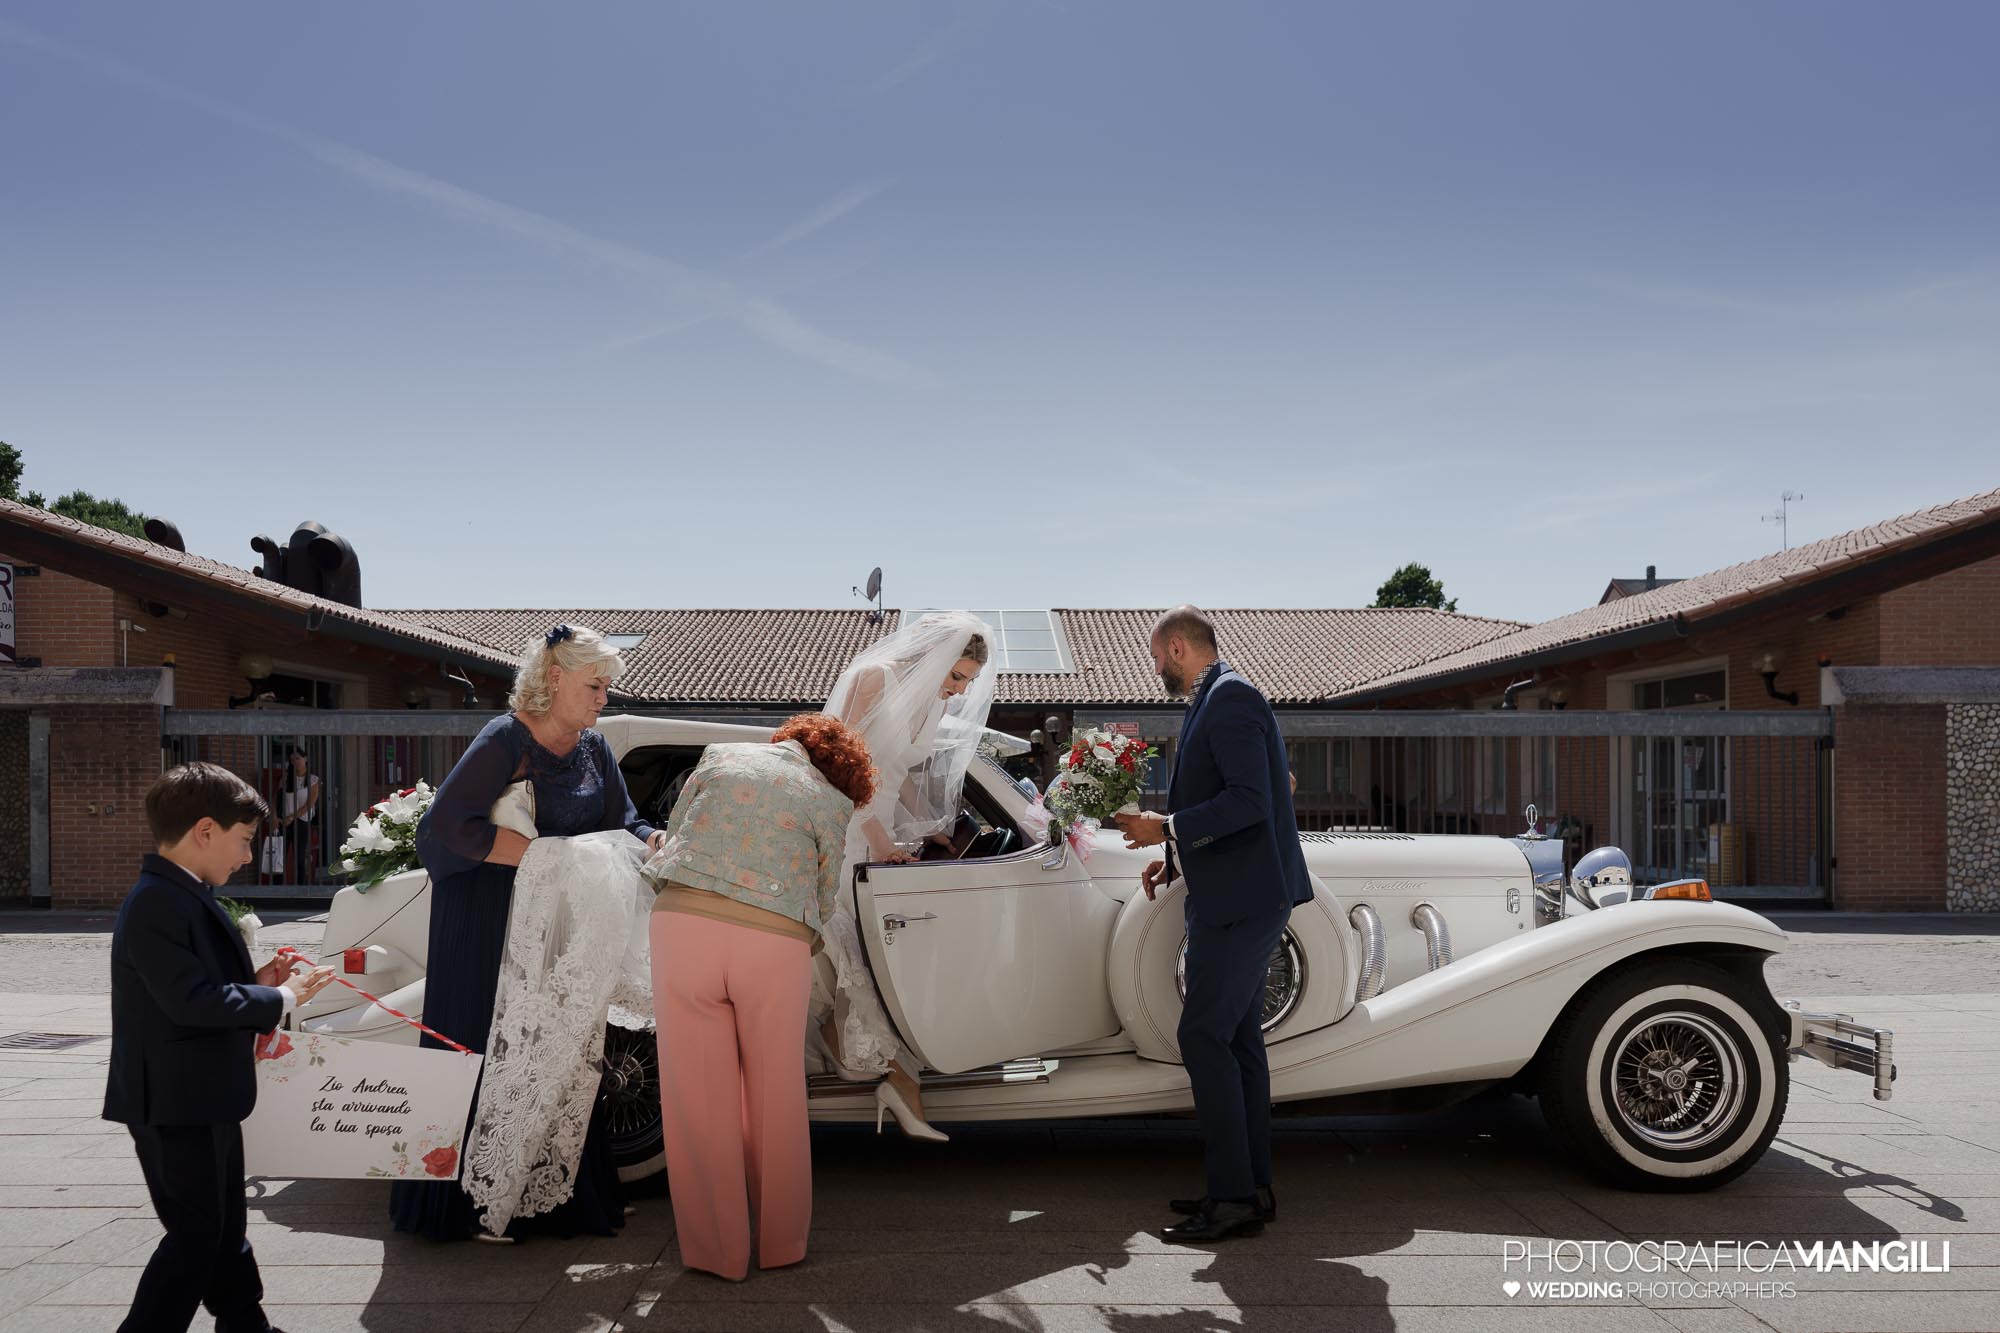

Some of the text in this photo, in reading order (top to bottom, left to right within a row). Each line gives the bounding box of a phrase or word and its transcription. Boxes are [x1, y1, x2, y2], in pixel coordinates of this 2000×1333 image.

[318, 1075, 344, 1092] Zio
[311, 1097, 412, 1114] sta arrivando
[310, 1115, 403, 1139] la tua sposa
